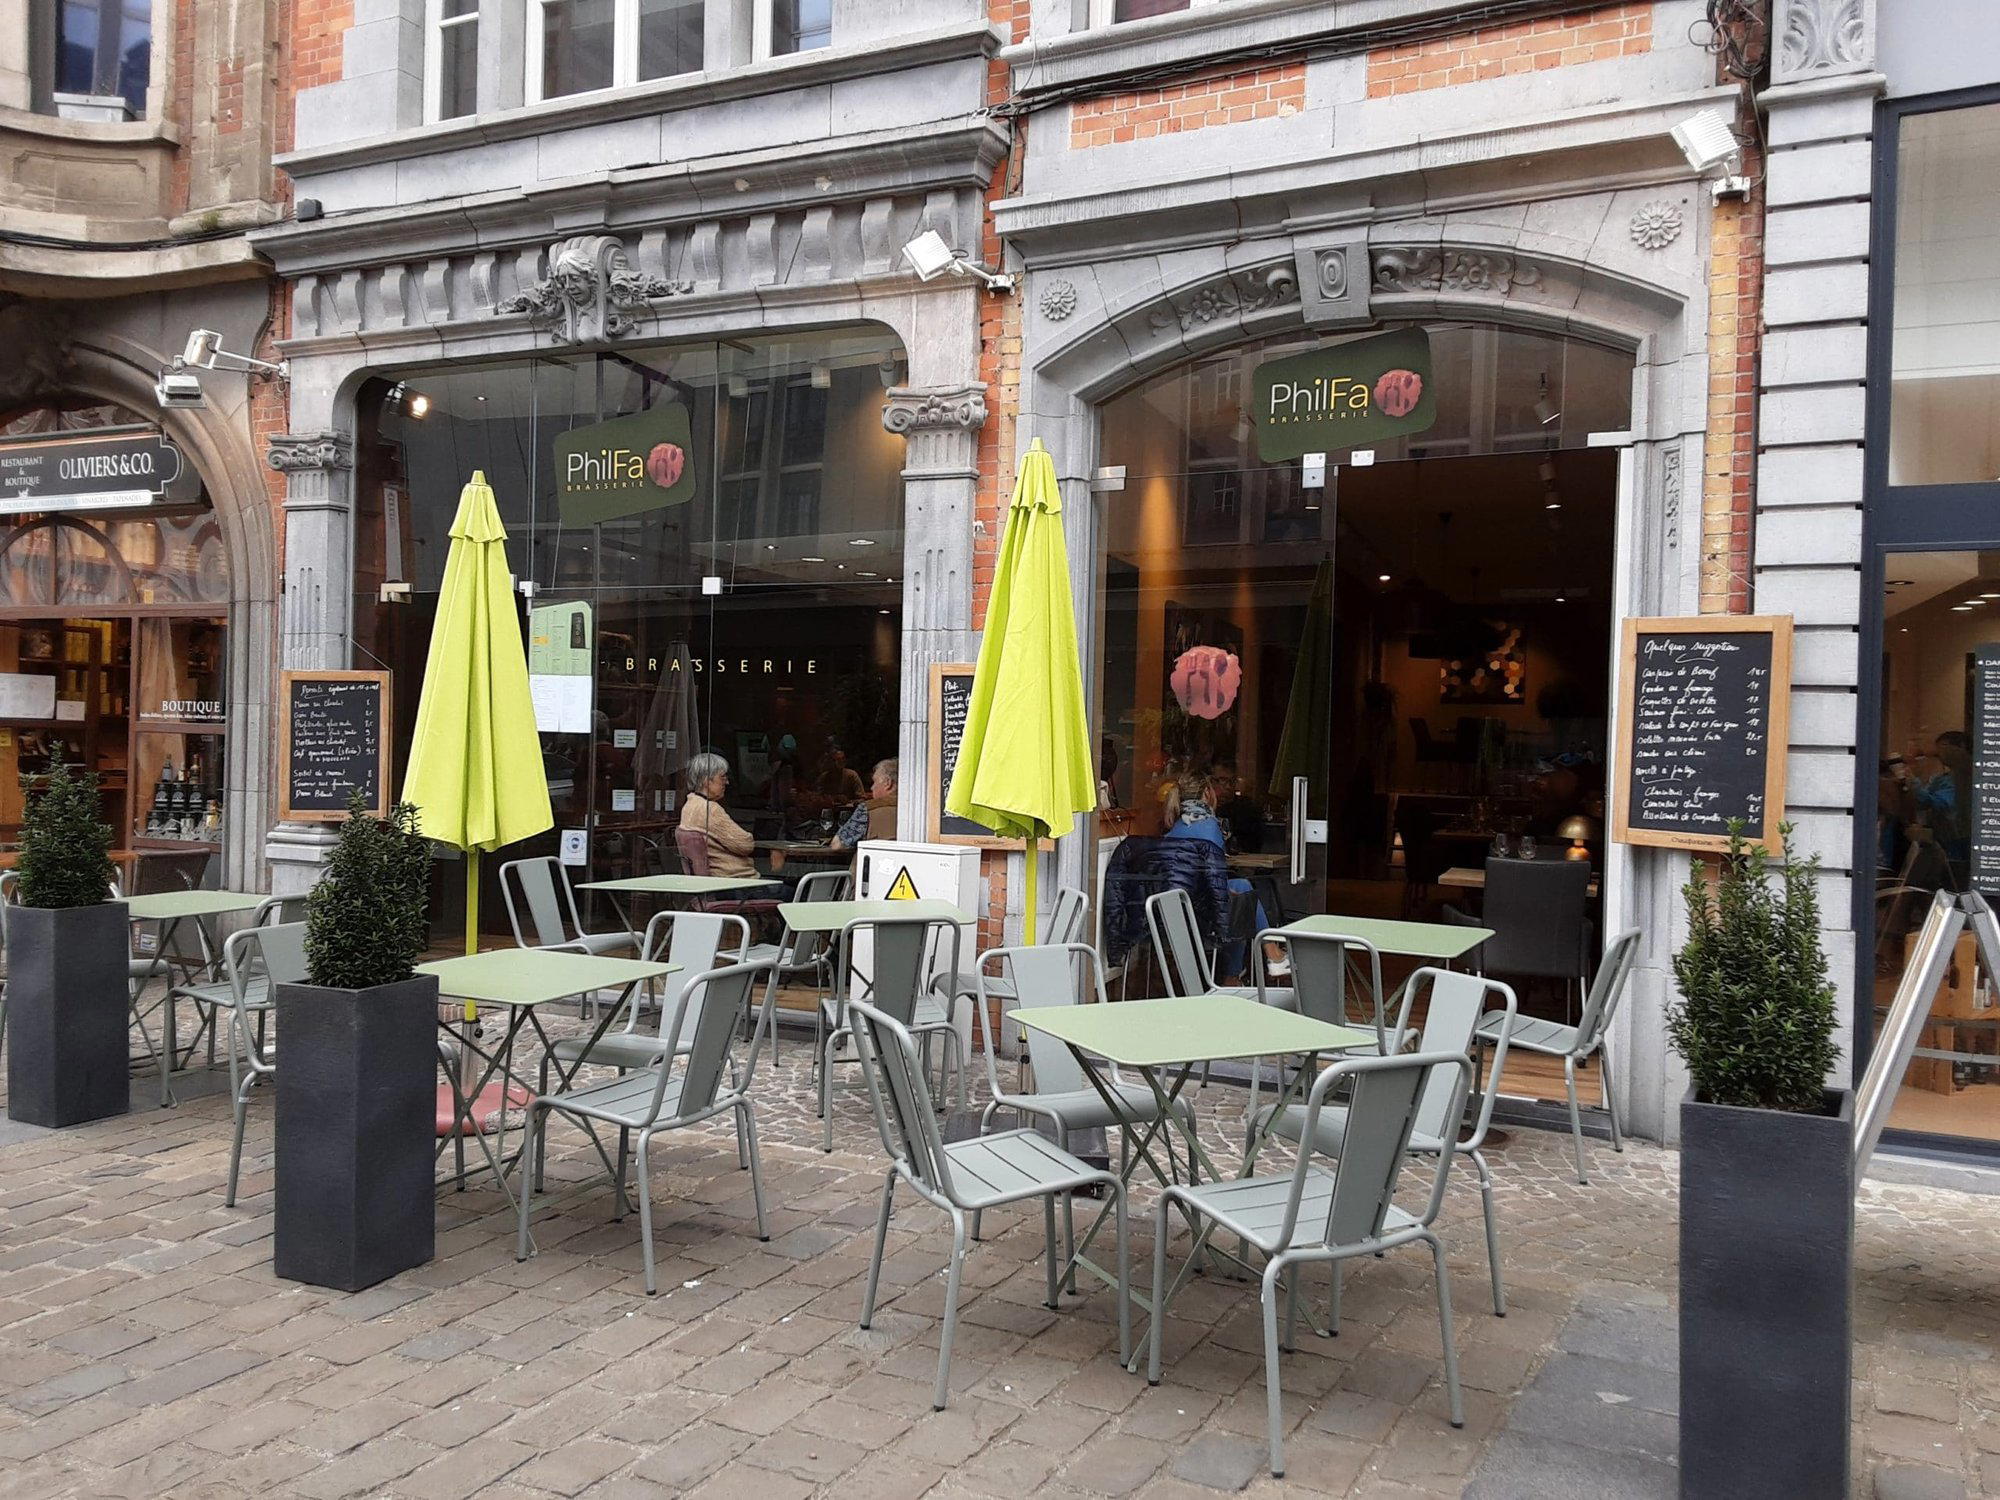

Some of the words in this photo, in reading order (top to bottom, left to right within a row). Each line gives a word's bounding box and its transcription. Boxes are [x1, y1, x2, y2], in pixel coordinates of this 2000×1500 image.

[1270, 377, 1369, 415] PhilFa
[1270, 410, 1368, 424] BRASSERIE
[1, 456, 44, 467] RESTAURANT
[567, 449, 644, 482] PhilFa
[5, 476, 40, 486] BOUTIQUE
[566, 481, 644, 492] BRASSERIE
[626, 658, 816, 674] BRASSERIE
[162, 700, 220, 714] BOUTIQUE
